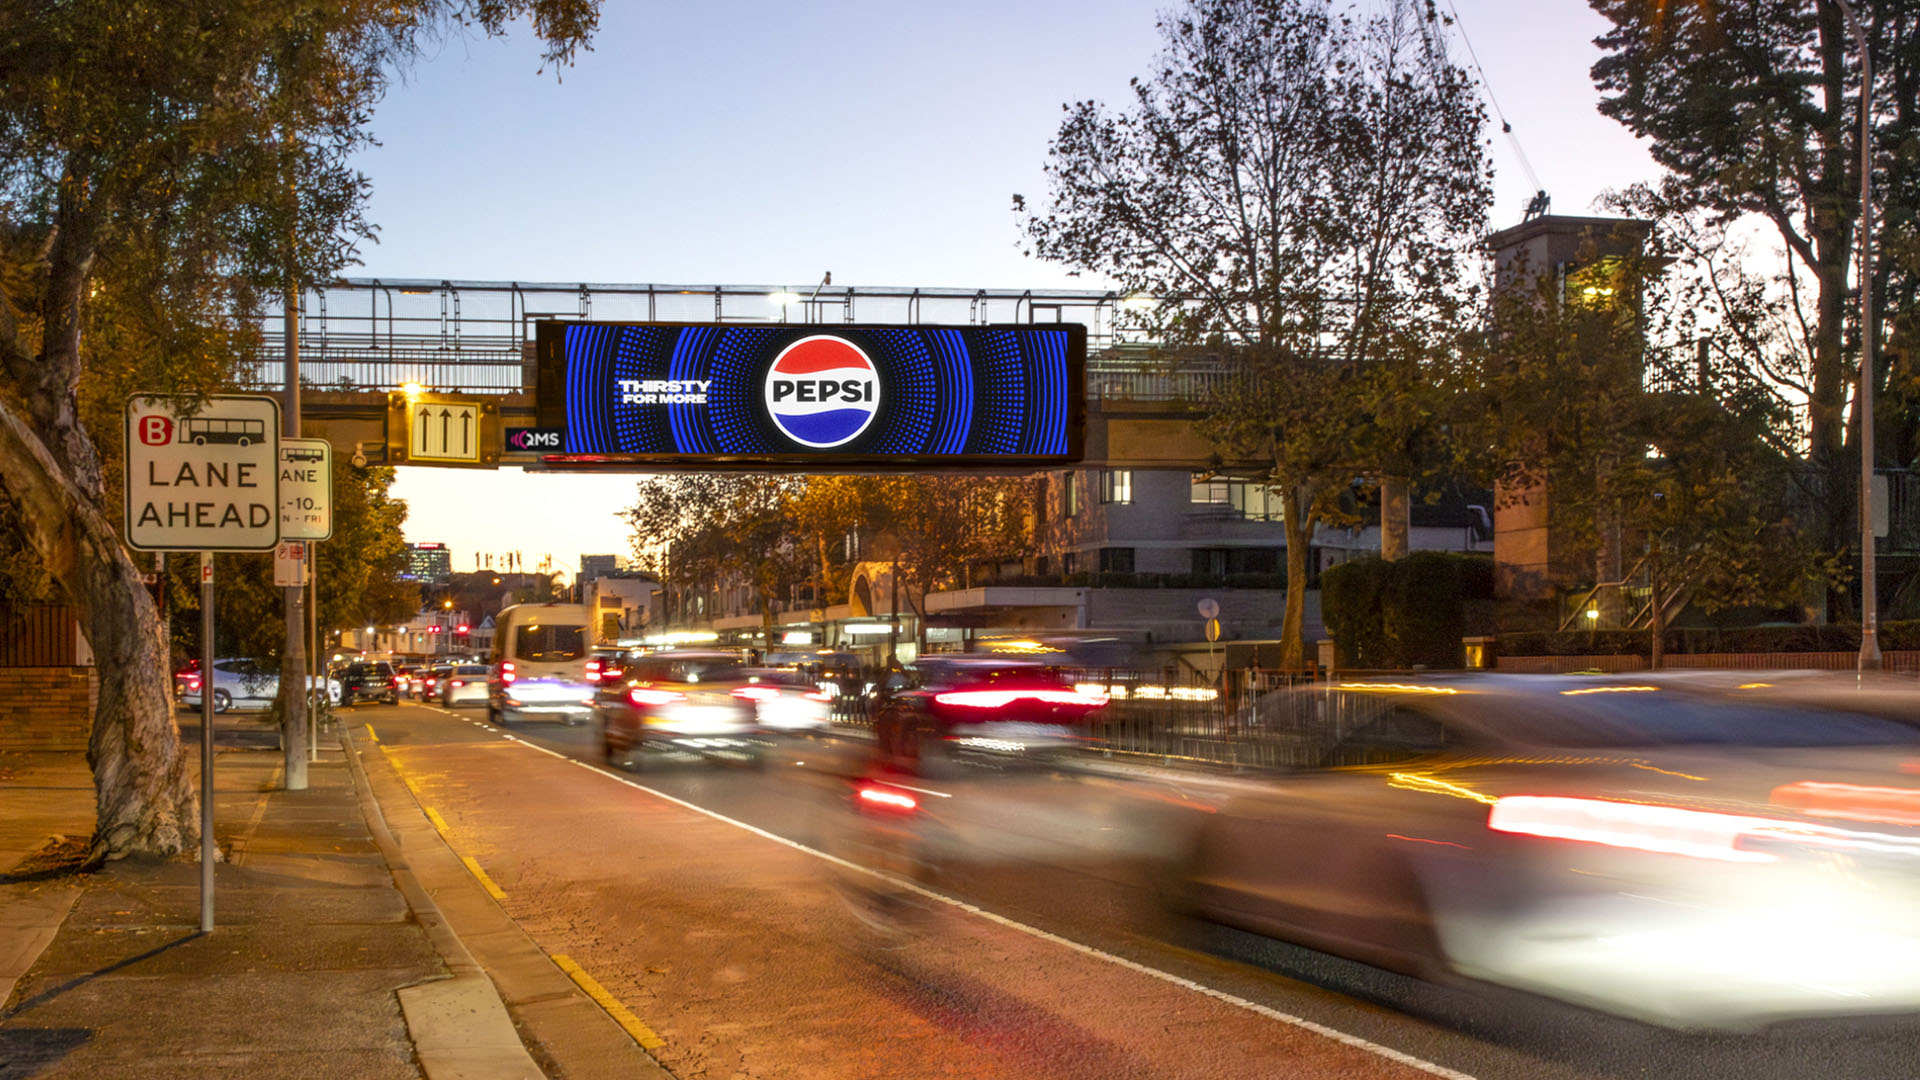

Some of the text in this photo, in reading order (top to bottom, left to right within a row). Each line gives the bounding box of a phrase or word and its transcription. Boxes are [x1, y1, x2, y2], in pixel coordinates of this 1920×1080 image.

[618, 380, 712, 392] THIRSTY
[773, 379, 872, 403] PEPSI
[623, 394, 707, 404] FOR MORE
[146, 417, 166, 444] B
[518, 430, 560, 449] QMS
[149, 460, 257, 488] LANE
[280, 469, 317, 482] ANE
[137, 502, 270, 528] AHEAD
[304, 514, 321, 523] FRI
